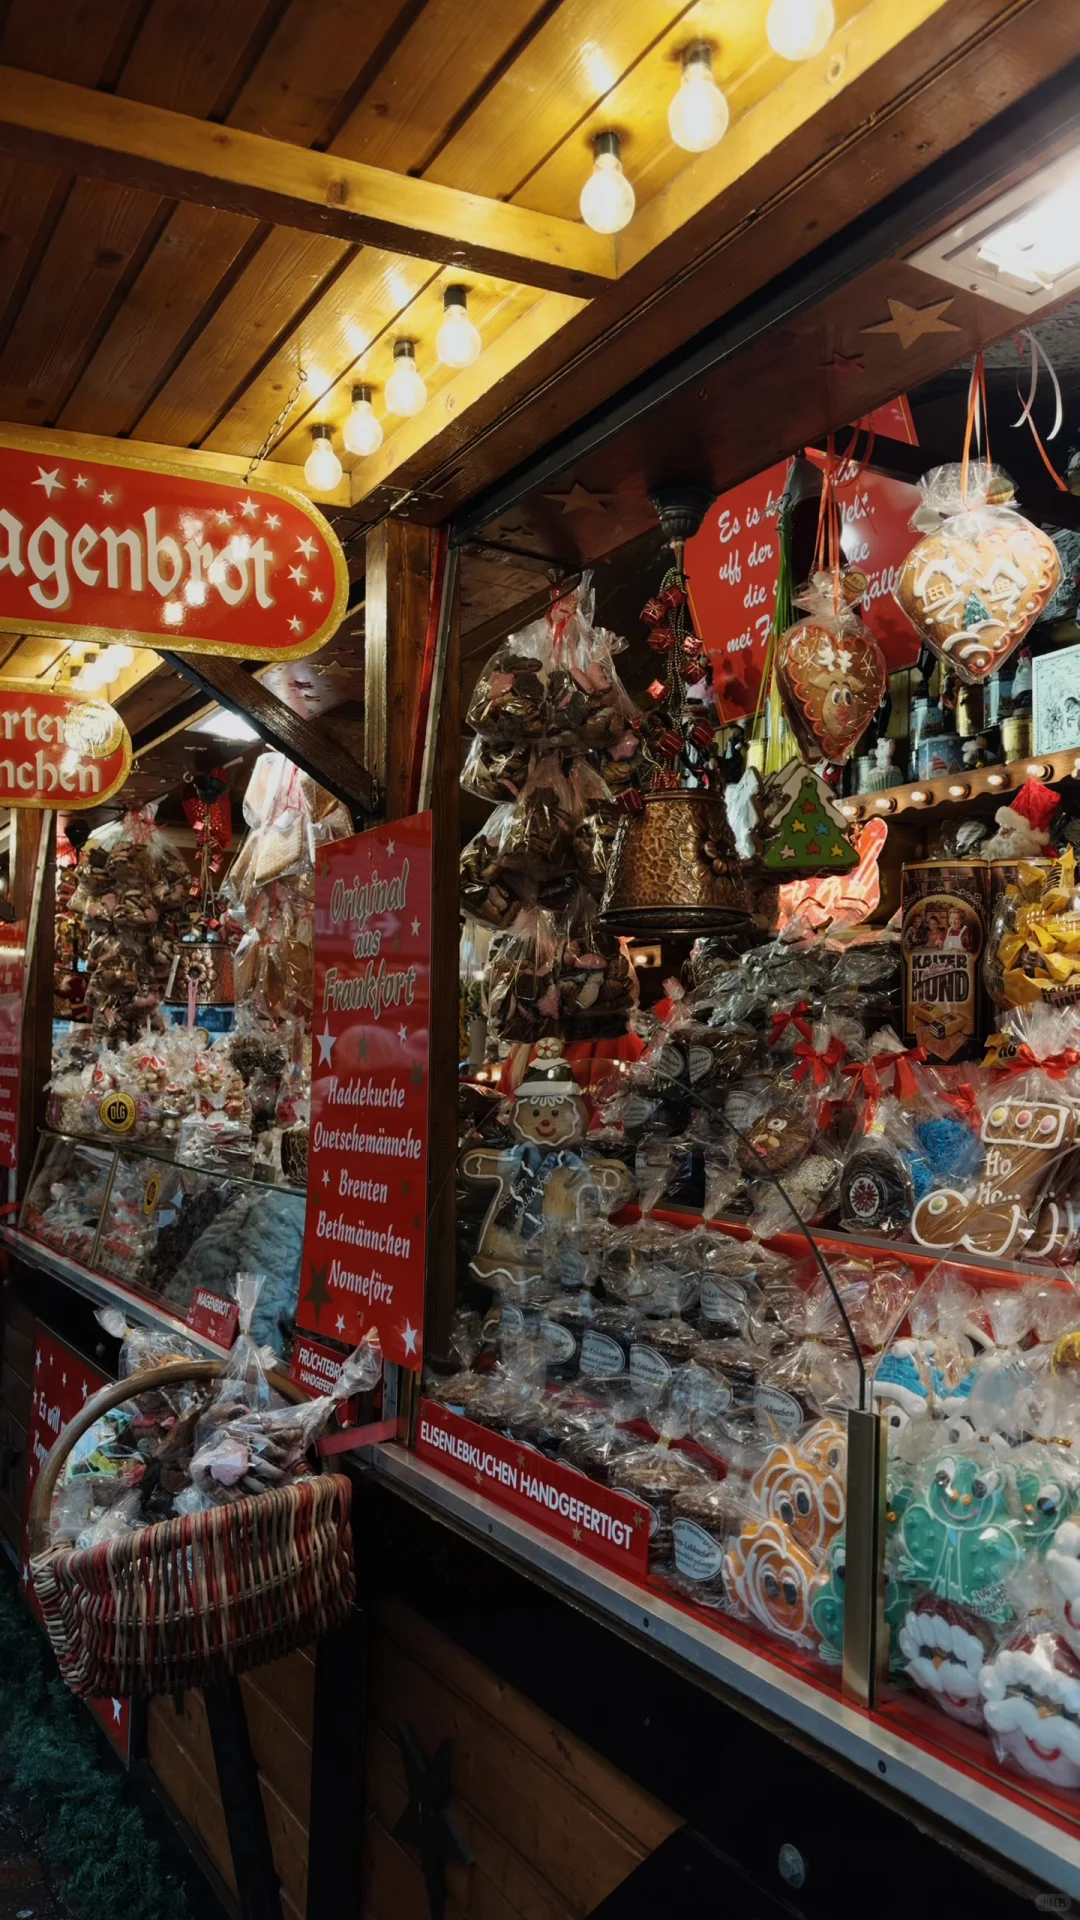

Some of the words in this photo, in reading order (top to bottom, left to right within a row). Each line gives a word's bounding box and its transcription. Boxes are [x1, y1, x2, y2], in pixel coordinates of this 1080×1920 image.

[718, 510, 741, 543] Es
[719, 549, 742, 585] uff
[748, 541, 773, 567] der
[743, 583, 767, 608] die
[727, 628, 753, 654] mei
[330, 857, 410, 931] Original
[353, 930, 382, 959] aus
[912, 955, 967, 970] KALTER
[323, 958, 416, 1020] Frankfort
[911, 970, 970, 1003] HUND
[327, 1077, 405, 1108] Haddekuche
[313, 1121, 422, 1160] Quetschemännche
[985, 1150, 1012, 1176] Ho
[338, 1168, 388, 1204] Brenten
[316, 1210, 411, 1259] Bethmännchen
[328, 1259, 394, 1306] Nonneförz
[196, 1292, 231, 1317] MAGENBROT
[420, 1421, 518, 1489] ELISENLEBKUCHEN
[520, 1471, 633, 1549] HANDGEFERTIGT
